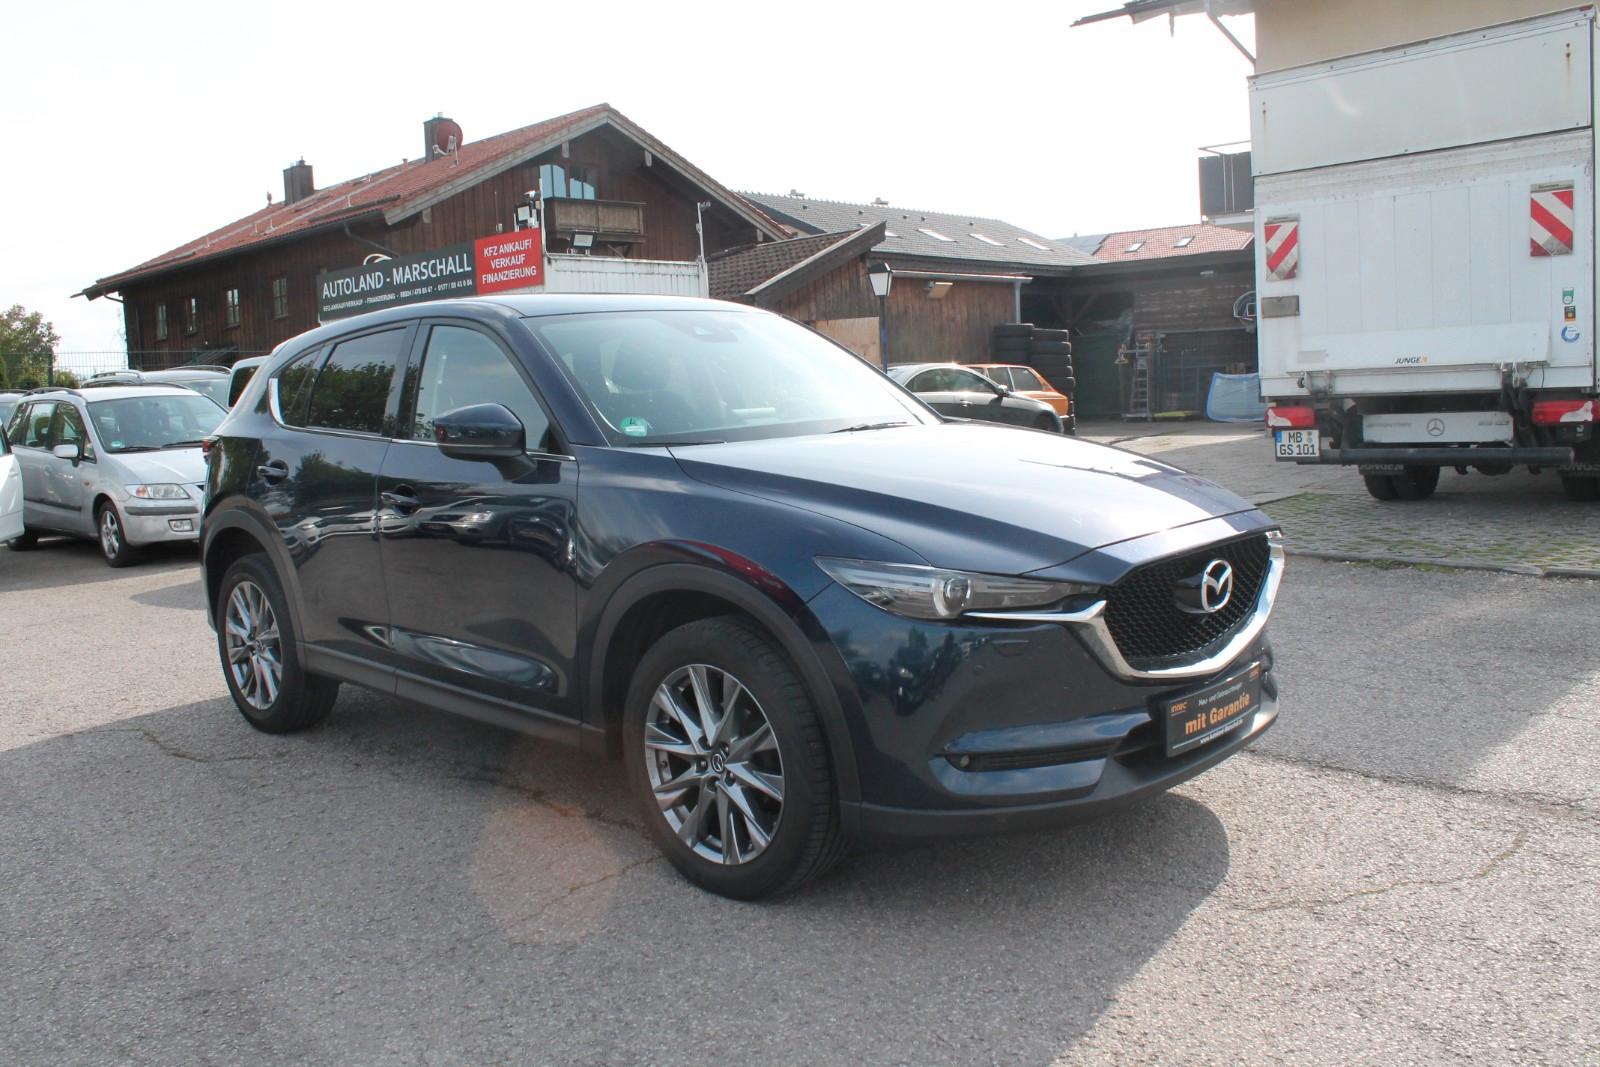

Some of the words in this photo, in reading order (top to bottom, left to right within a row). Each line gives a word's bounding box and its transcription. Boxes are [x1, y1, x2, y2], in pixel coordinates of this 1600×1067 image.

[483, 246, 498, 257] KFZ
[490, 254, 526, 269] VERKAUF
[322, 271, 384, 299] AUTOLAND
[392, 253, 472, 285] MARSCHALL
[482, 265, 537, 285] FINANZIERUNG
[1288, 431, 1303, 443] MB
[1280, 444, 1294, 456] GS
[1296, 444, 1316, 456] 101
[1185, 712, 1207, 735] mit
[1209, 691, 1251, 725] Garantie
